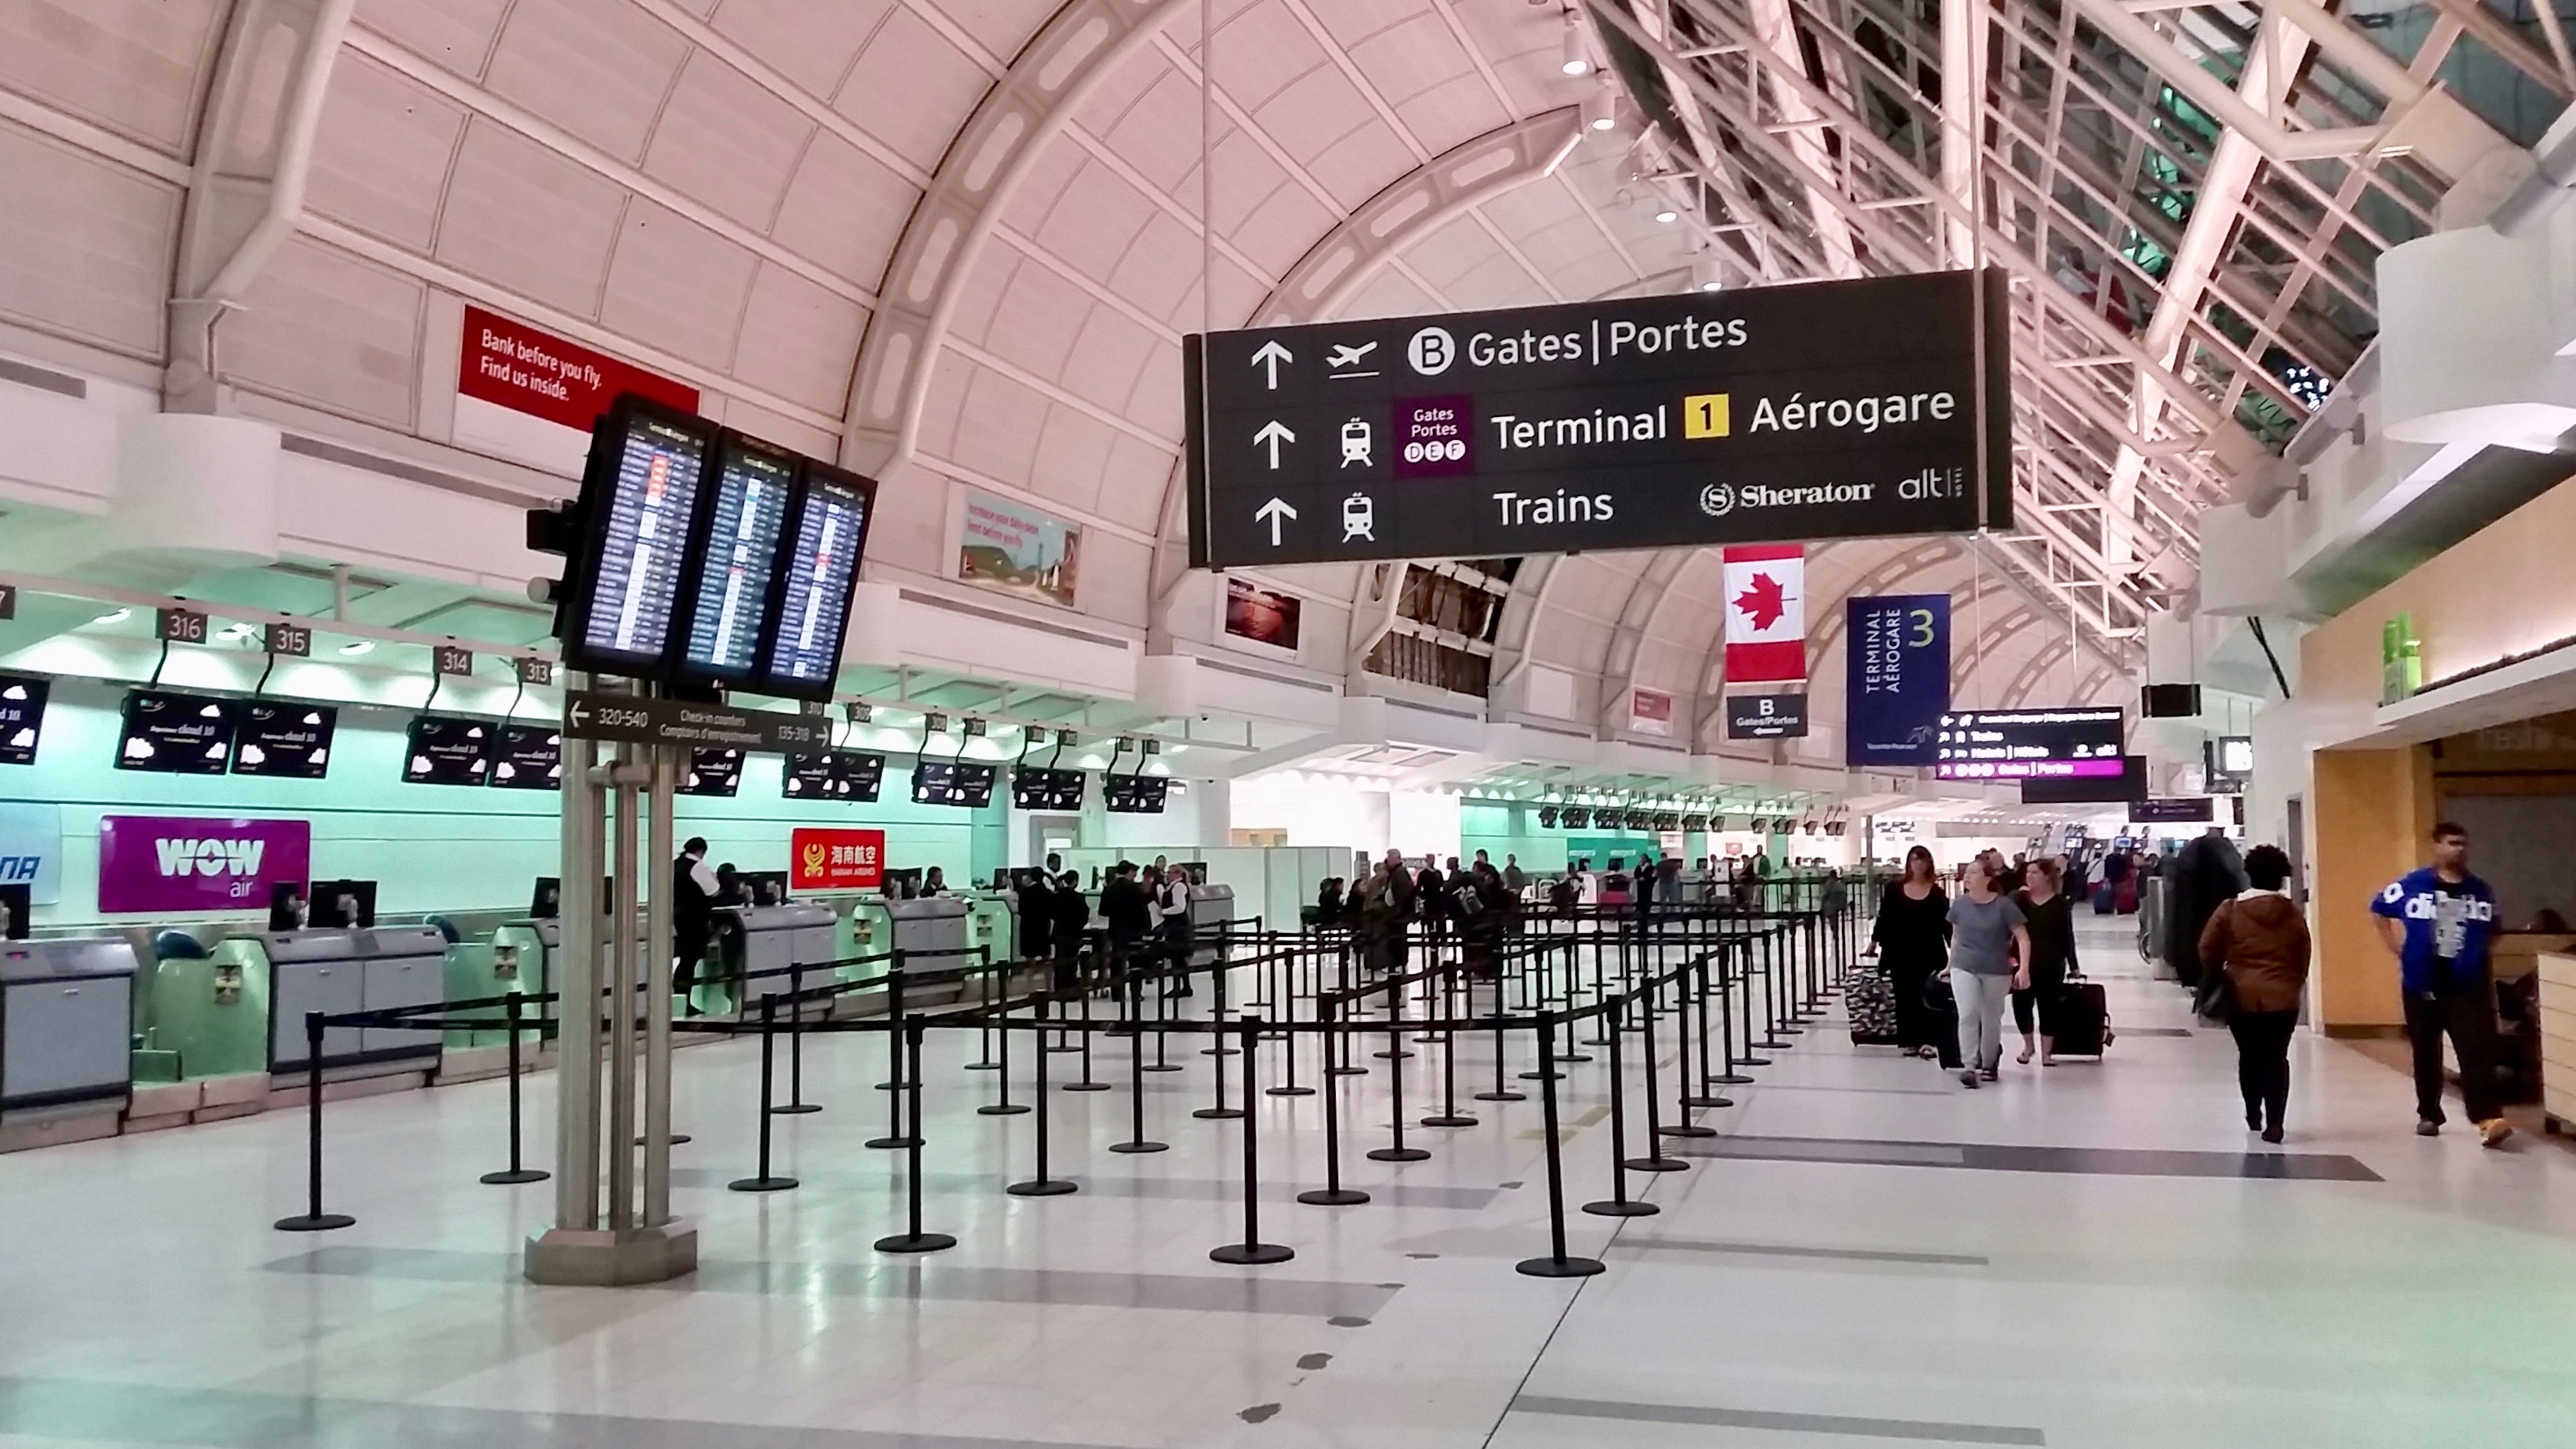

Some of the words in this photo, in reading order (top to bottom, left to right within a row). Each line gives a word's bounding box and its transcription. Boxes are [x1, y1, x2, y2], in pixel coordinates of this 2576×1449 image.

[1468, 330, 1583, 367] Gates
[1611, 315, 1748, 357] Portes
[482, 328, 515, 357] Bank
[517, 341, 558, 371] before
[559, 358, 583, 379] you
[584, 365, 603, 391] fly.
[480, 356, 511, 382] Find
[512, 369, 528, 388] us
[530, 372, 570, 402] inside.
[1413, 407, 1454, 423] Gates
[1491, 406, 1667, 450] Terminal
[1700, 402, 1713, 432] 1
[1749, 391, 1956, 434] Aérogare
[1410, 423, 1458, 438] Portes
[1740, 482, 1874, 508] Sheraton
[1897, 468, 1943, 500] alt
[1493, 488, 1615, 526] Trains
[169, 615, 202, 639] 316
[276, 630, 306, 653] 315
[1908, 608, 1935, 648] 3
[442, 652, 468, 671] 314
[1866, 610, 1881, 694] TERMINAL
[1883, 608, 1902, 693] AÉROGARE
[526, 663, 549, 681] 313
[598, 707, 648, 728] 320-540
[1759, 698, 1775, 716] B
[155, 838, 265, 877] WOW
[230, 878, 253, 897] air
